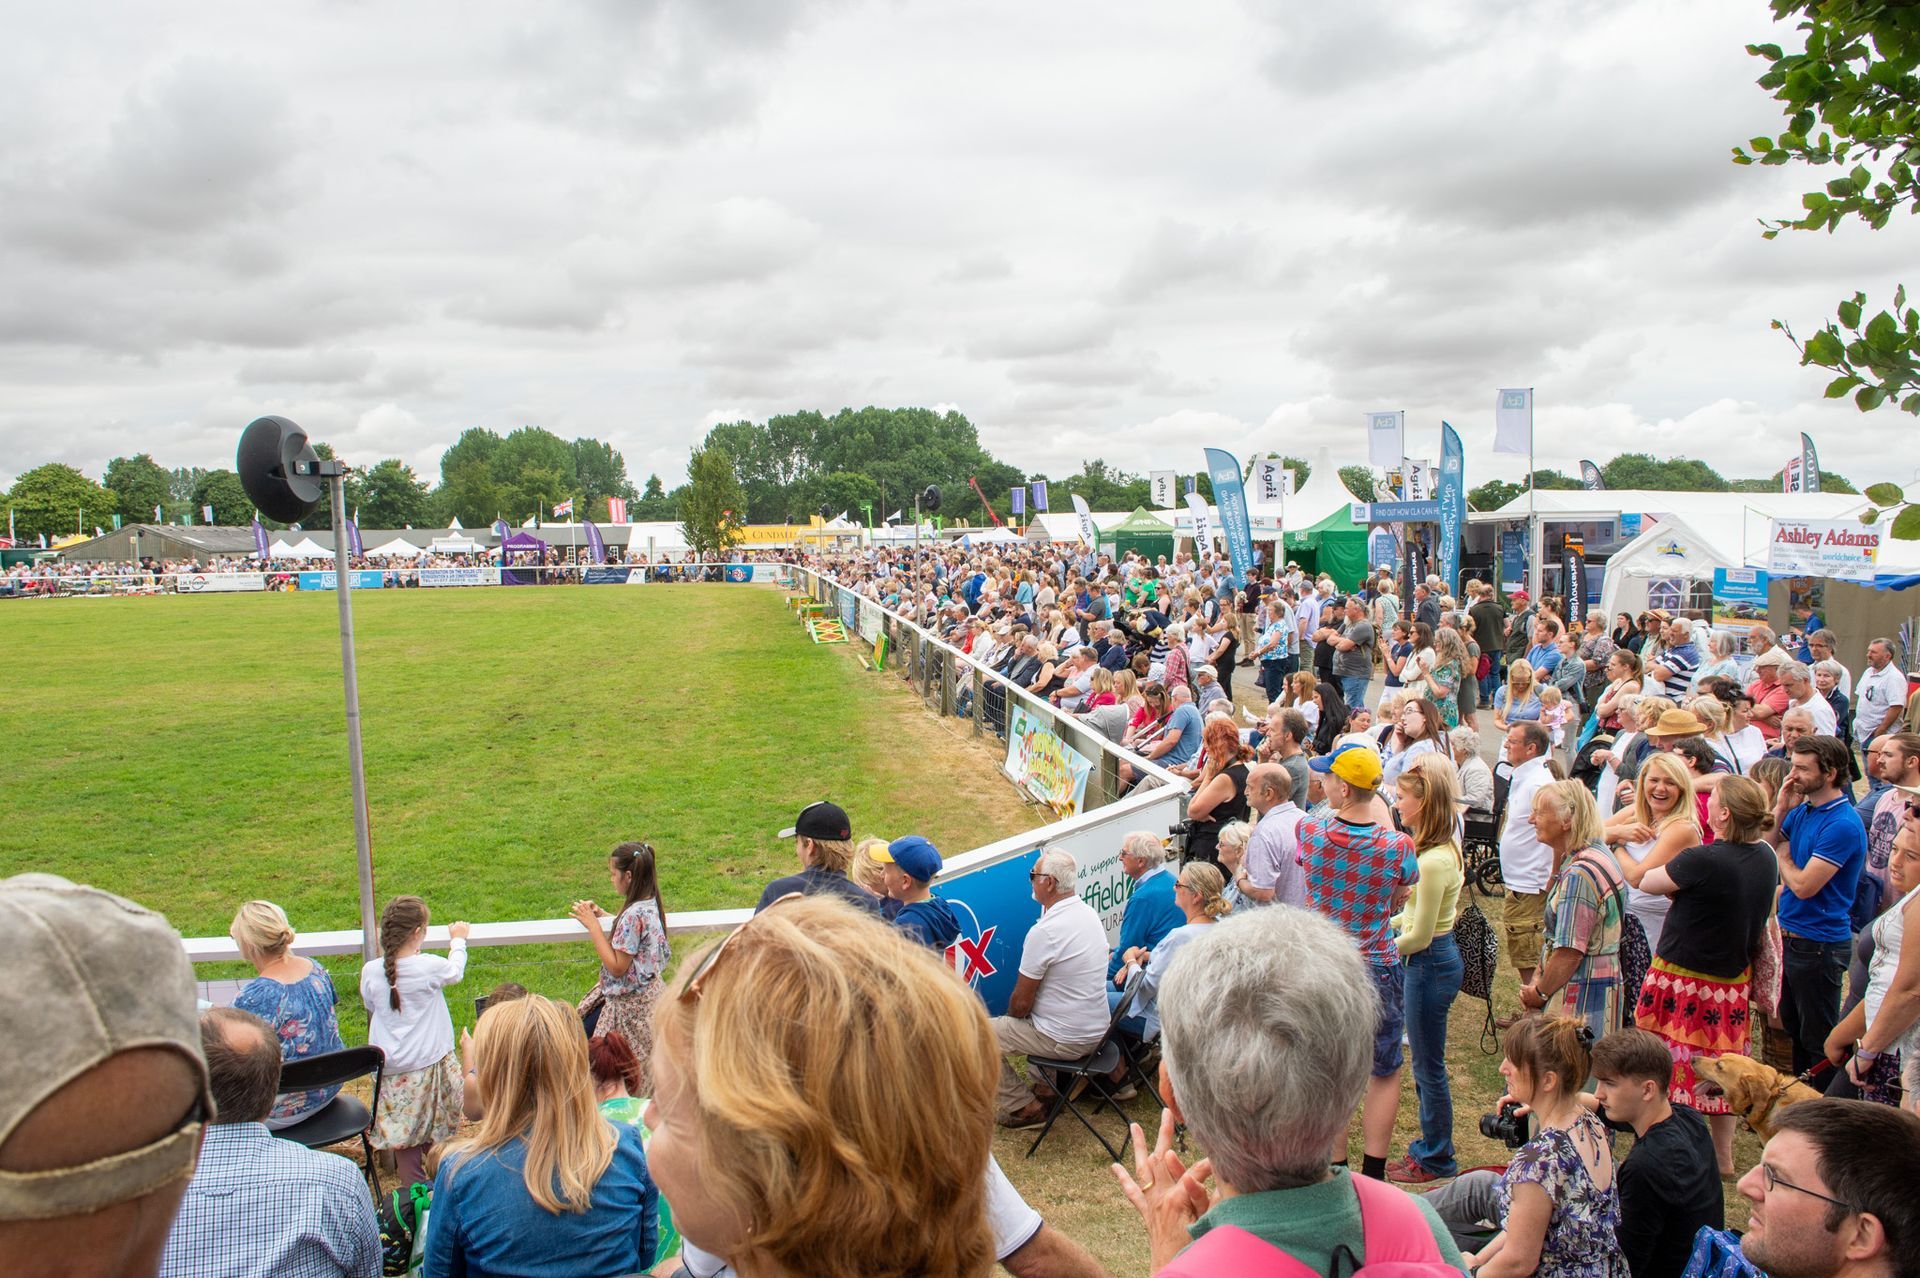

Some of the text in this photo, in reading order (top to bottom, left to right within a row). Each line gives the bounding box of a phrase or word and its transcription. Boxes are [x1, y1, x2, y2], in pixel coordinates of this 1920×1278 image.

[1261, 464, 1277, 499] Agrii
[1410, 465, 1422, 500] Agrii
[1775, 527, 1879, 549] Ashley Adams
[1077, 865, 1087, 879] nd
[1080, 871, 1125, 913] ffield
